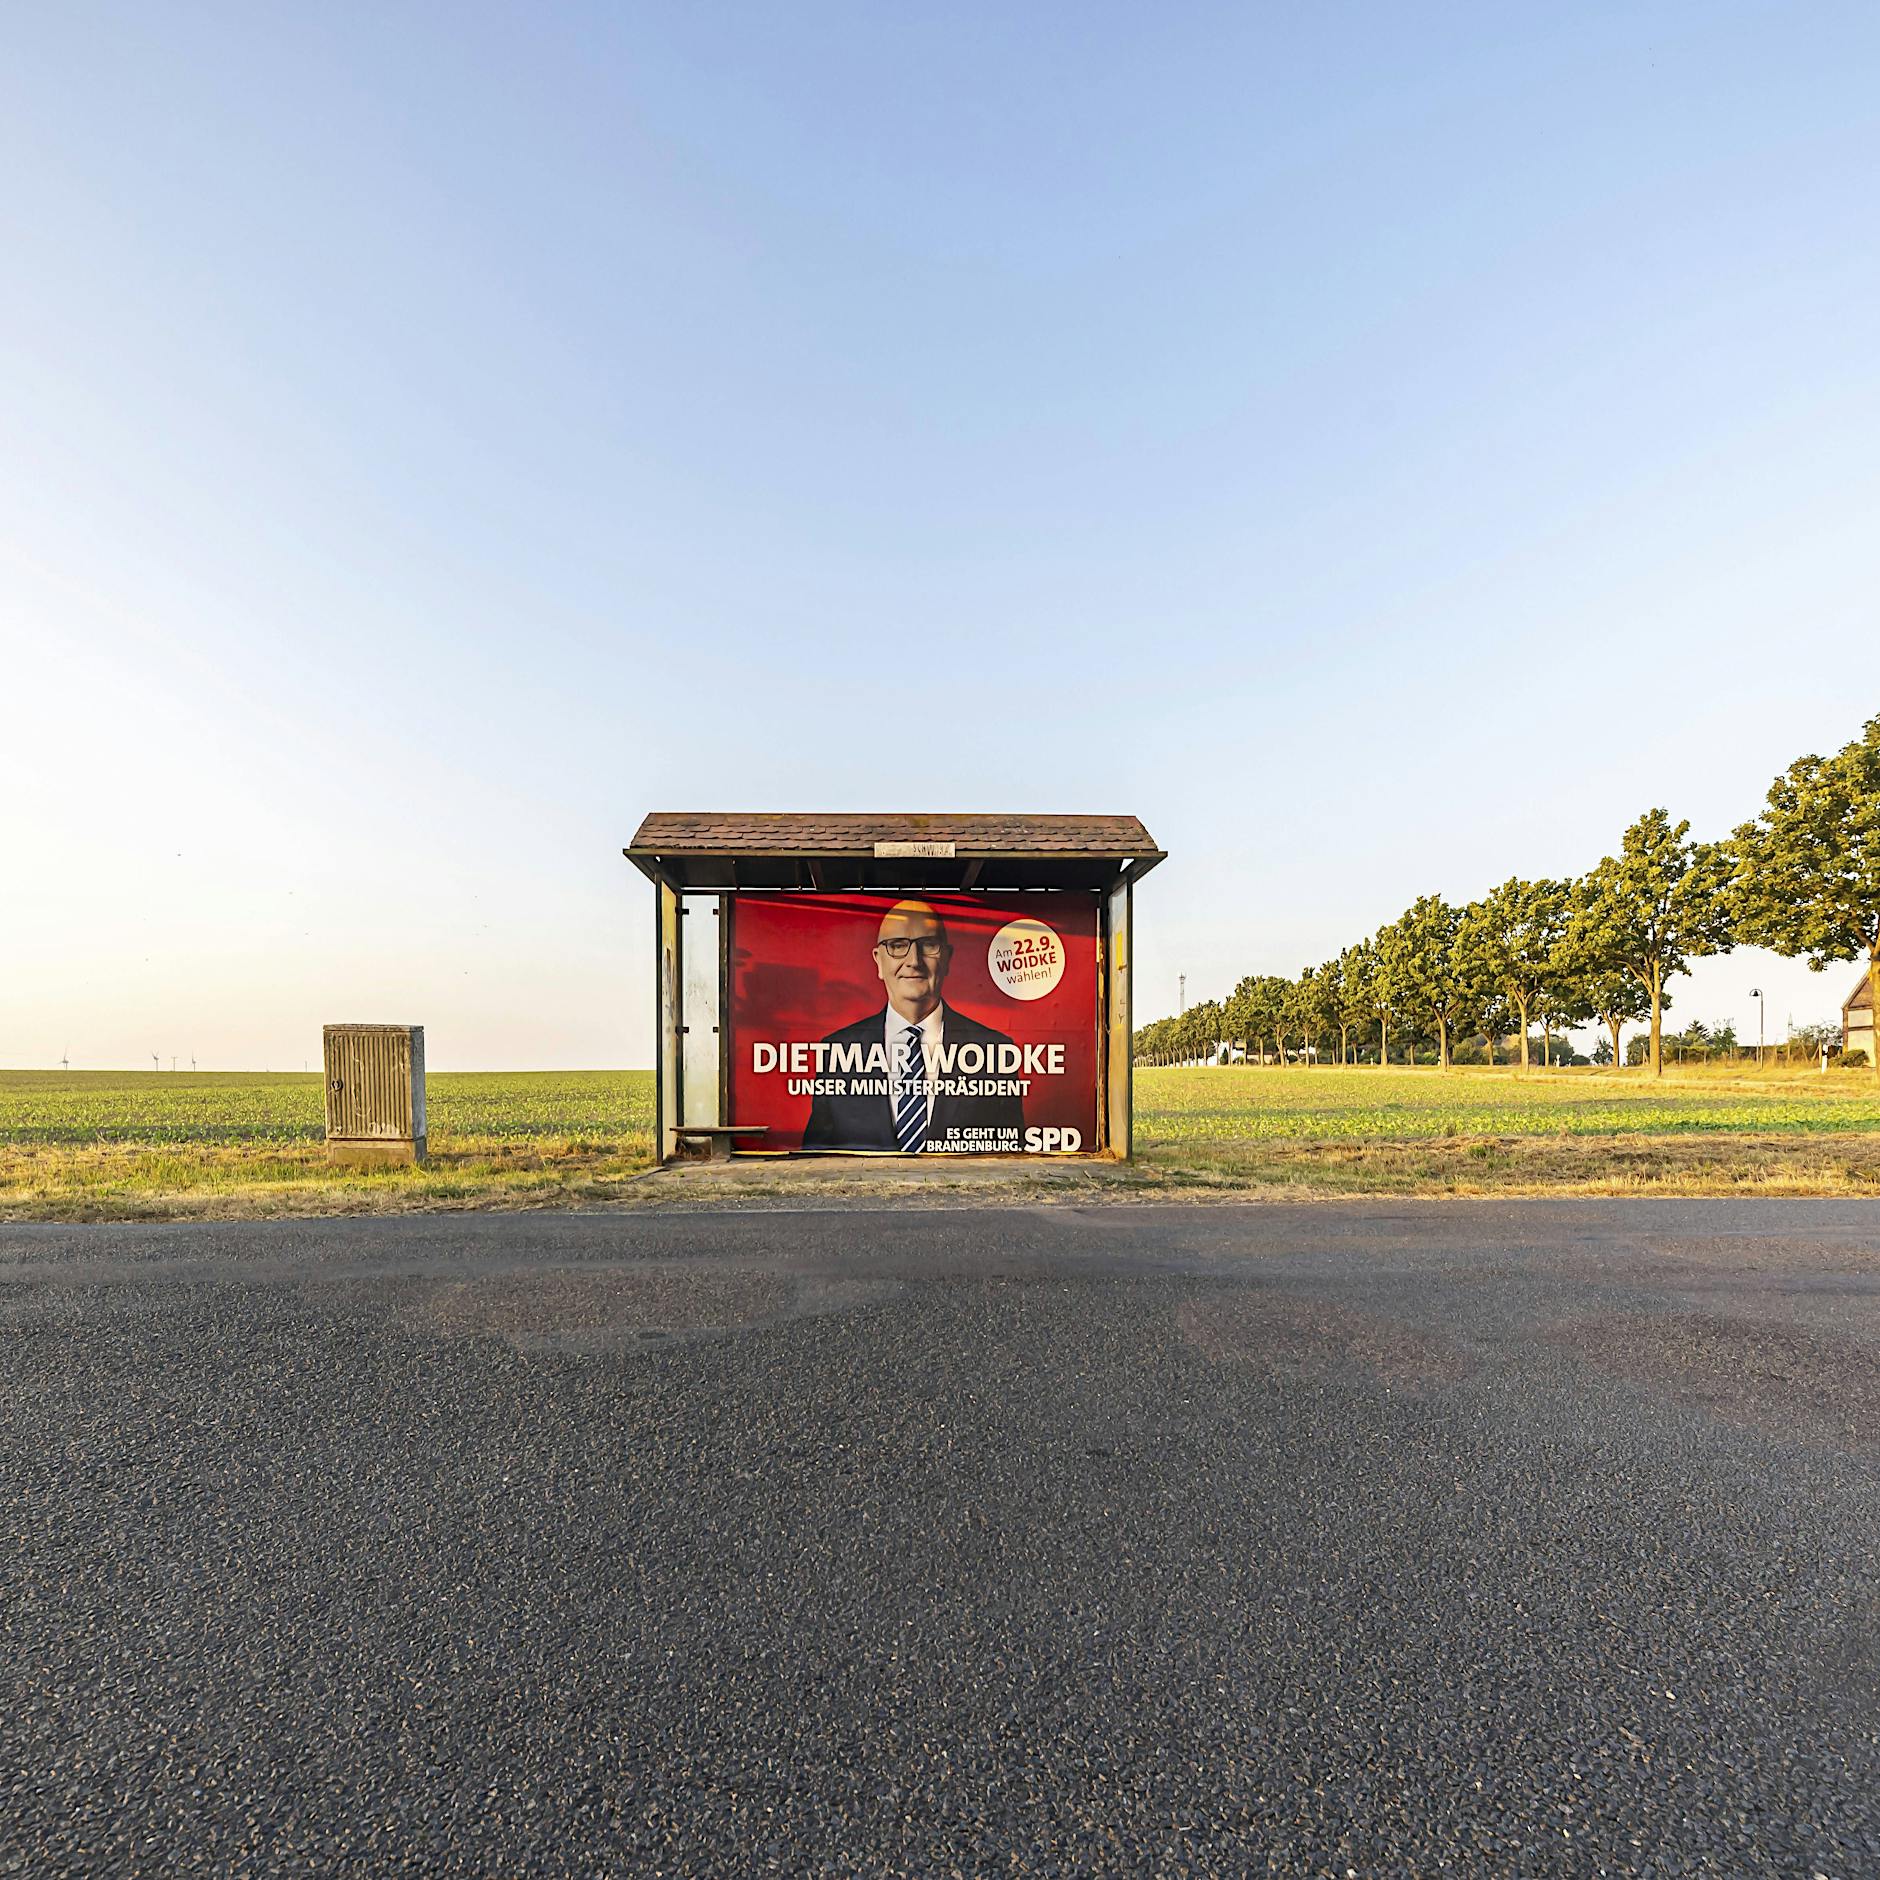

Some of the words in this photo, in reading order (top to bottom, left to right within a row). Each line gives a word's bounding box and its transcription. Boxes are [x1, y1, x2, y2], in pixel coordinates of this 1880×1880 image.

[995, 949, 1013, 959] Am
[1013, 936, 1055, 956] 22.9.
[996, 951, 1057, 973] WOIDKE
[1006, 967, 1052, 984] wählen!
[753, 1042, 913, 1073] DIETMAR
[920, 1043, 1065, 1074] WOIDKE
[787, 1078, 847, 1096] UNSER
[850, 1076, 1031, 1097] MINISTERPRÄSIDENT
[946, 1127, 960, 1140] ES
[962, 1127, 995, 1140] GEHT
[997, 1127, 1019, 1140] UM
[1024, 1126, 1082, 1152] SPD
[926, 1140, 1022, 1152] BRANDENBURG.
